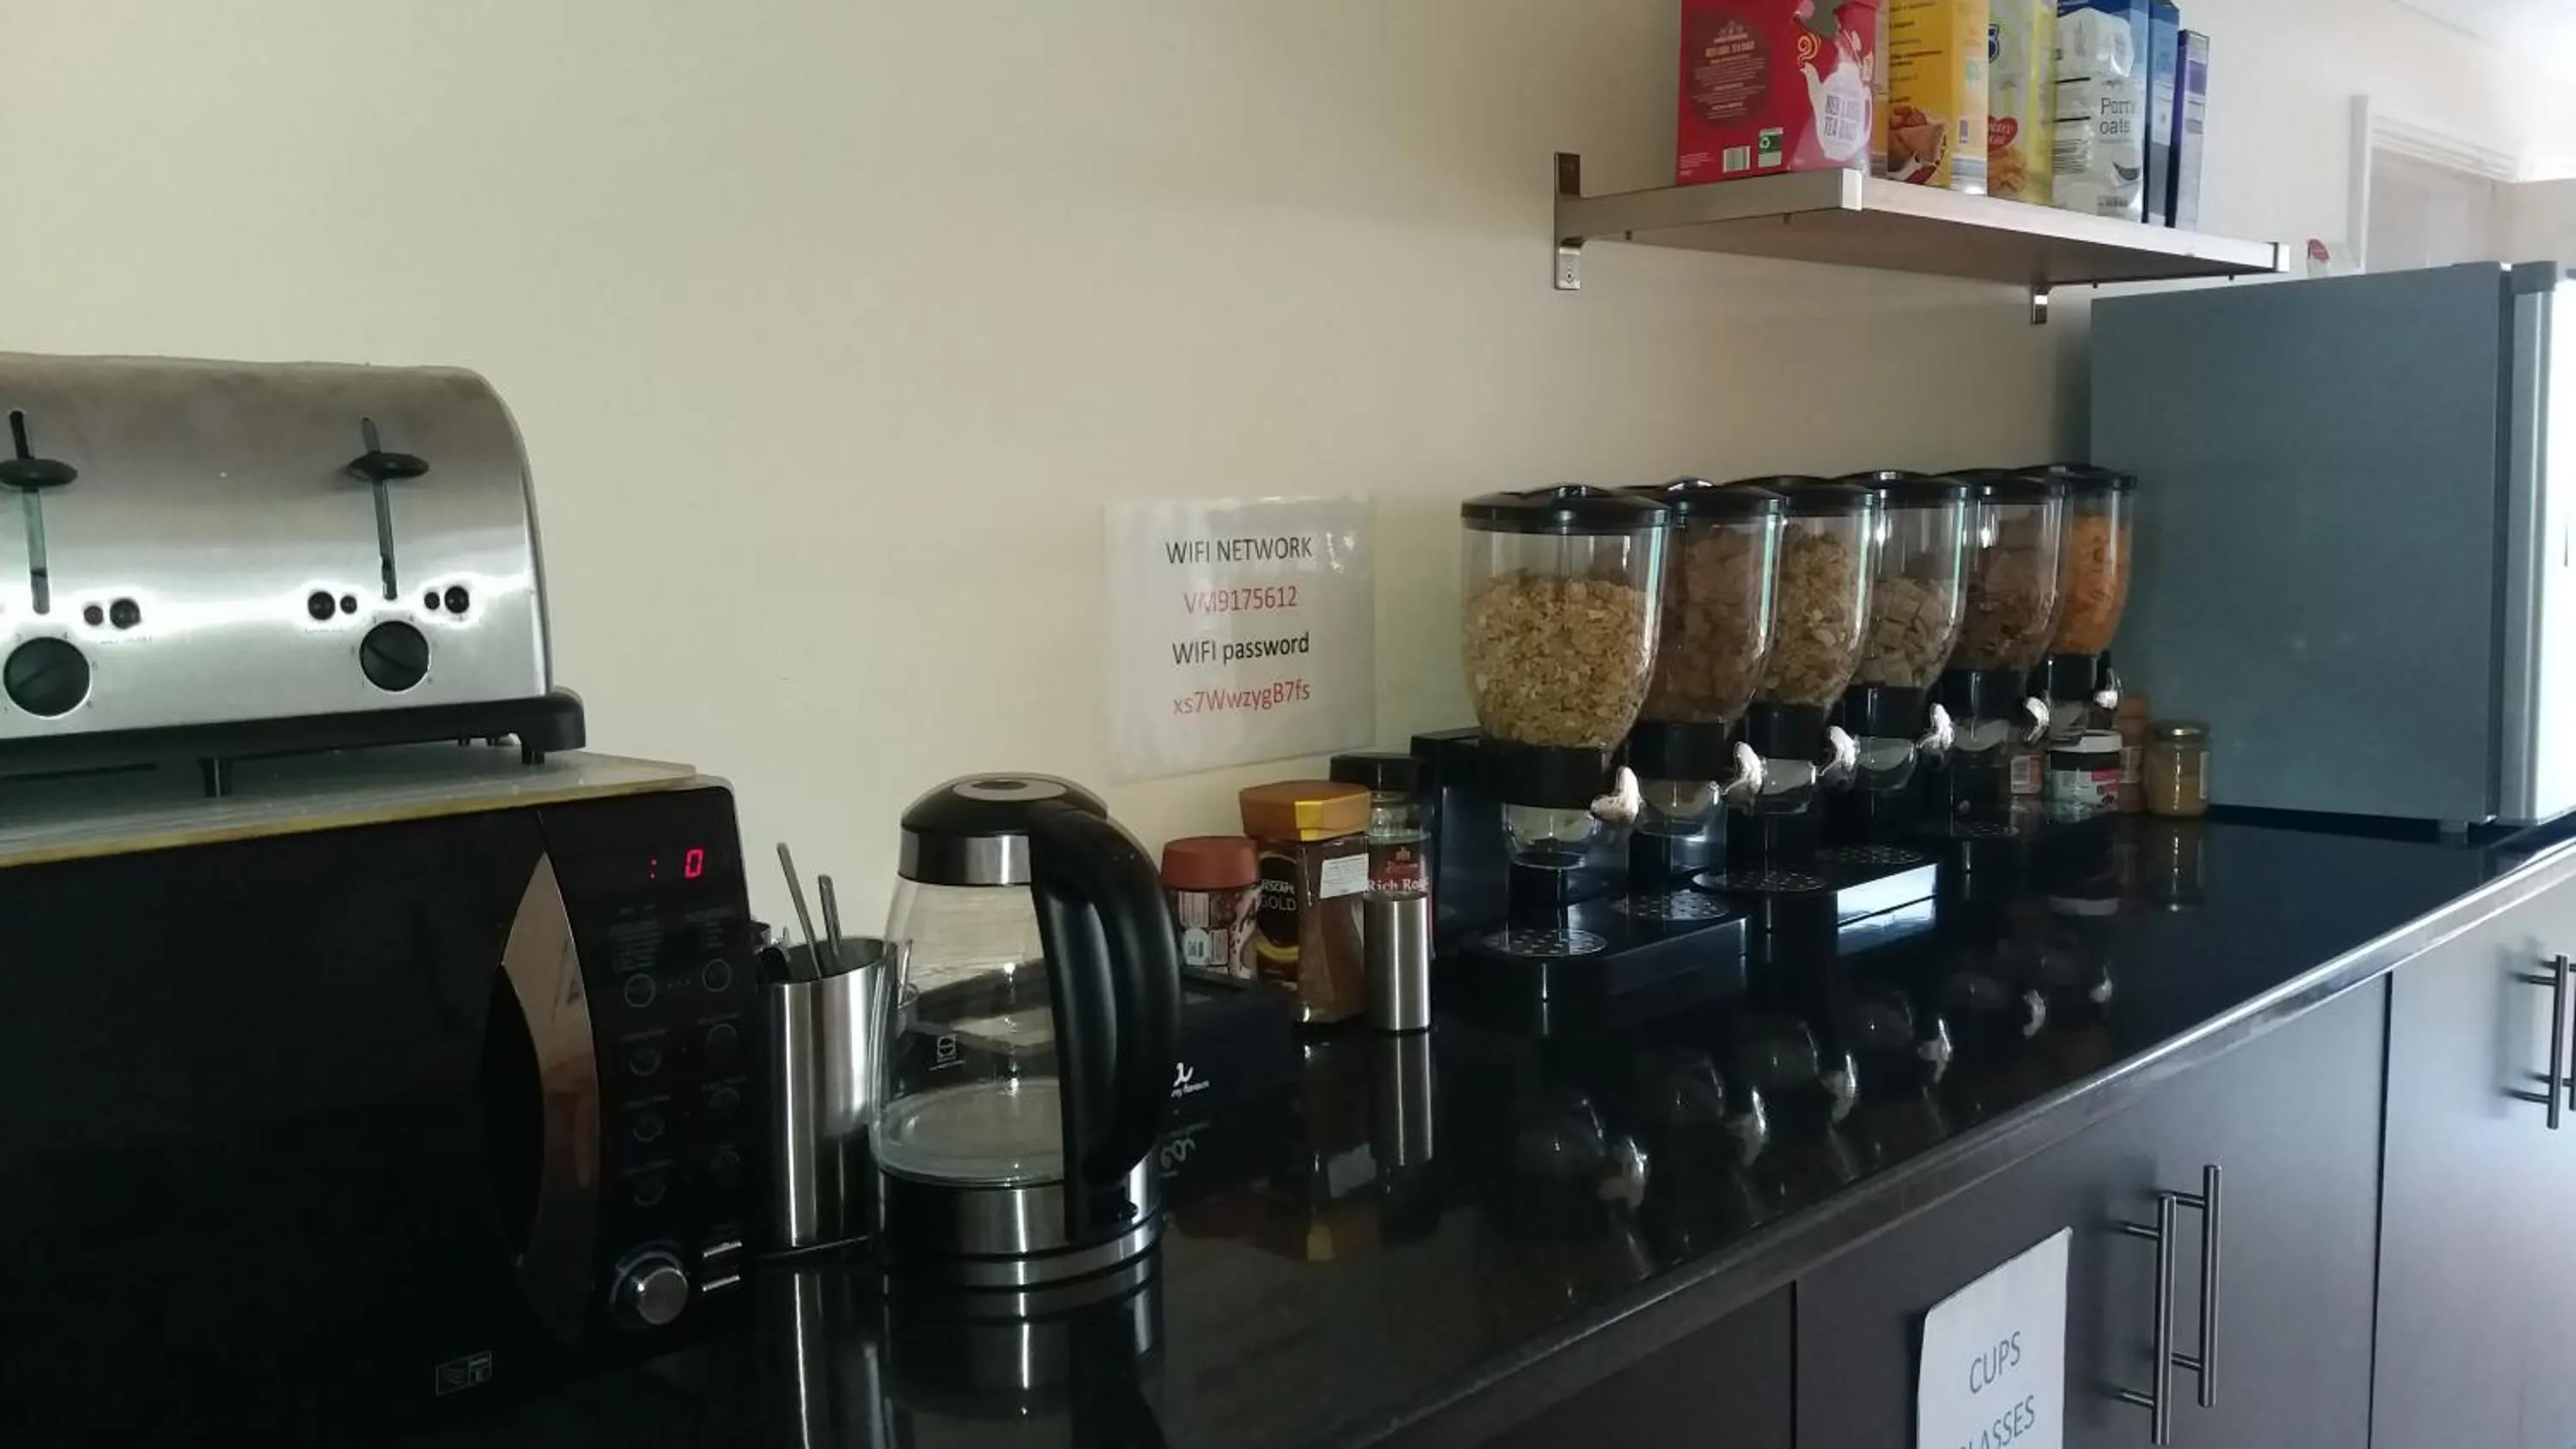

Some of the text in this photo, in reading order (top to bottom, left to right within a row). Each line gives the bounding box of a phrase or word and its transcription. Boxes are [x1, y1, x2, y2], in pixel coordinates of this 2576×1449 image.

[2099, 118, 2130, 135] oats
[1165, 537, 1313, 564] WIFI NETWORK
[1183, 585, 1298, 614] VM9175612
[1172, 632, 1309, 666] WIFI password
[1173, 678, 1311, 715] xs7WwzygB7fs
[1368, 878, 1398, 892] Rich
[1969, 1331, 2021, 1395] CUPS
[1960, 1395, 2034, 1449] ASSES
